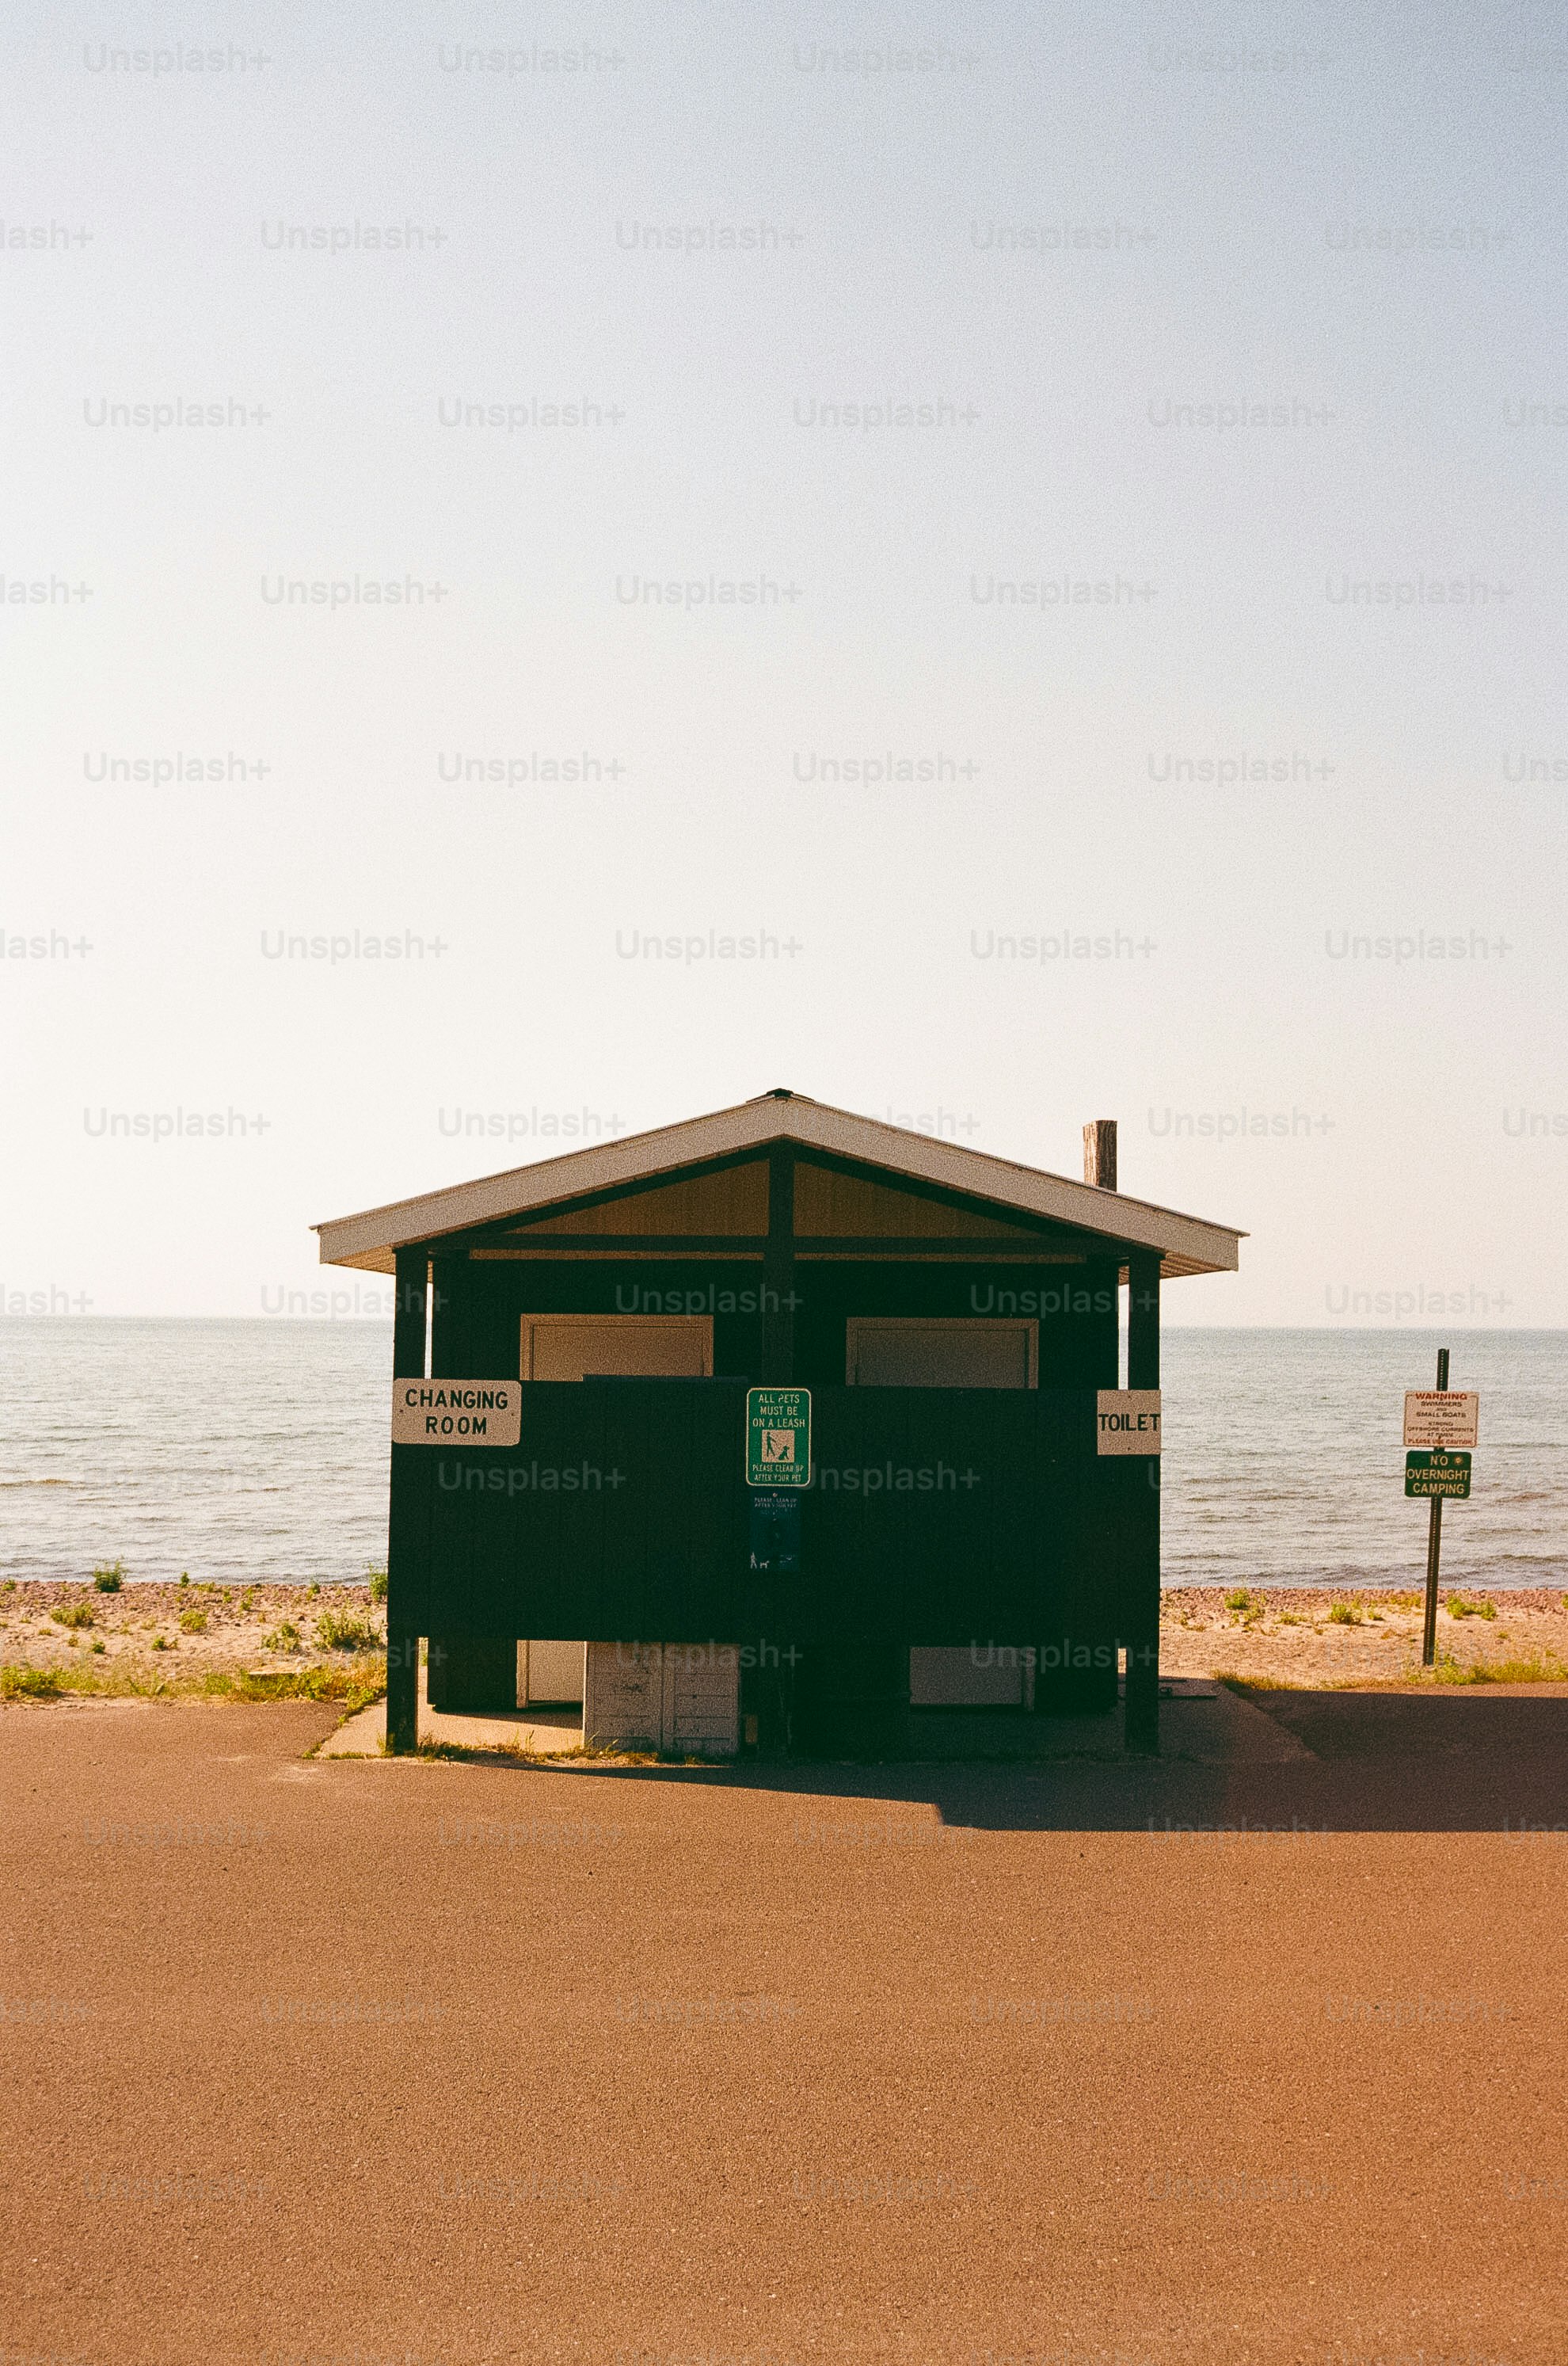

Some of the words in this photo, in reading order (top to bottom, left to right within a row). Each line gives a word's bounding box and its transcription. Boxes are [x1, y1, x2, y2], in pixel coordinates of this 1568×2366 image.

[405, 1389, 508, 1410] CHANGING
[759, 1394, 774, 1403] ALL
[760, 1406, 783, 1415] MUST
[787, 1406, 797, 1415] BE
[425, 1415, 487, 1434] ROOM
[752, 1418, 764, 1427] ON
[768, 1418, 774, 1427] A
[777, 1418, 805, 1427] LEASH
[1098, 1413, 1161, 1431] TOILET
[1430, 1456, 1448, 1465] NO
[1406, 1469, 1470, 1480] OVERNIGHT
[1413, 1483, 1464, 1494] CAMPING
